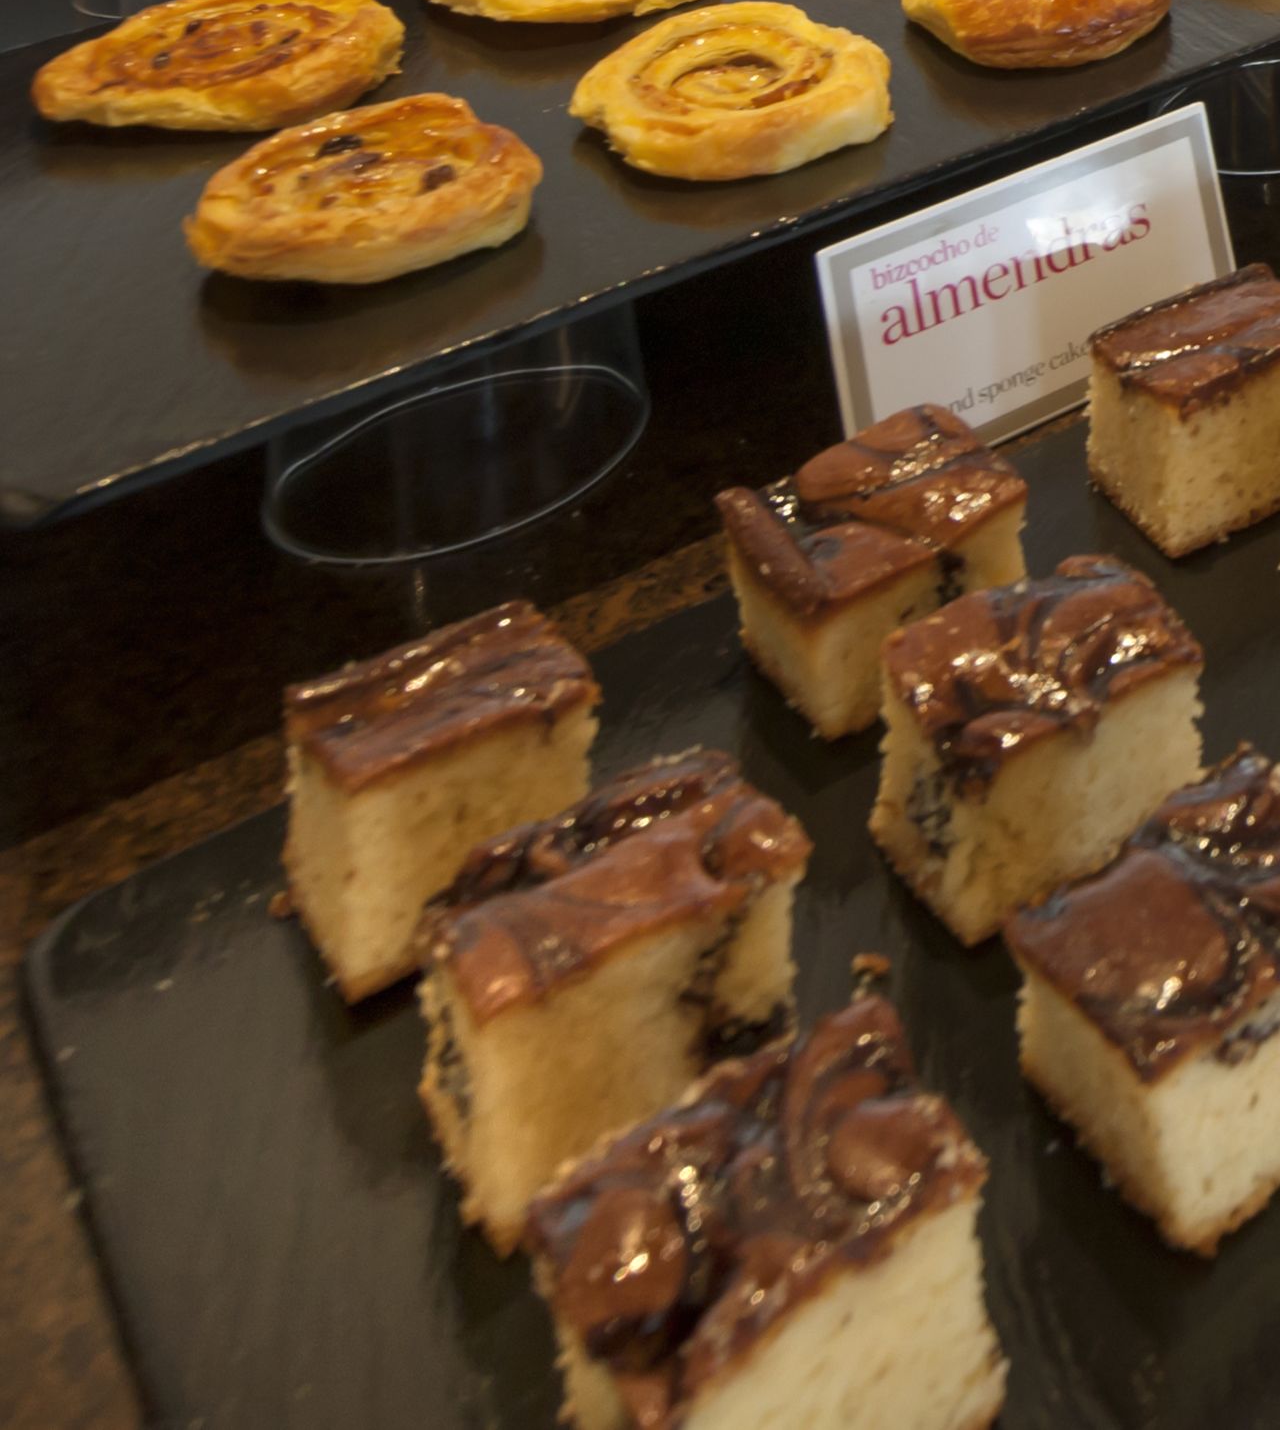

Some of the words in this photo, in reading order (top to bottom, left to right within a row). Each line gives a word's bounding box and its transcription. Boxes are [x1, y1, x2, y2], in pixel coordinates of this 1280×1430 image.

[870, 234, 971, 291] bizcocho
[973, 223, 999, 246] de
[880, 200, 1152, 346] almendras
[978, 358, 1046, 404] sponge
[1049, 341, 1089, 371] cake
